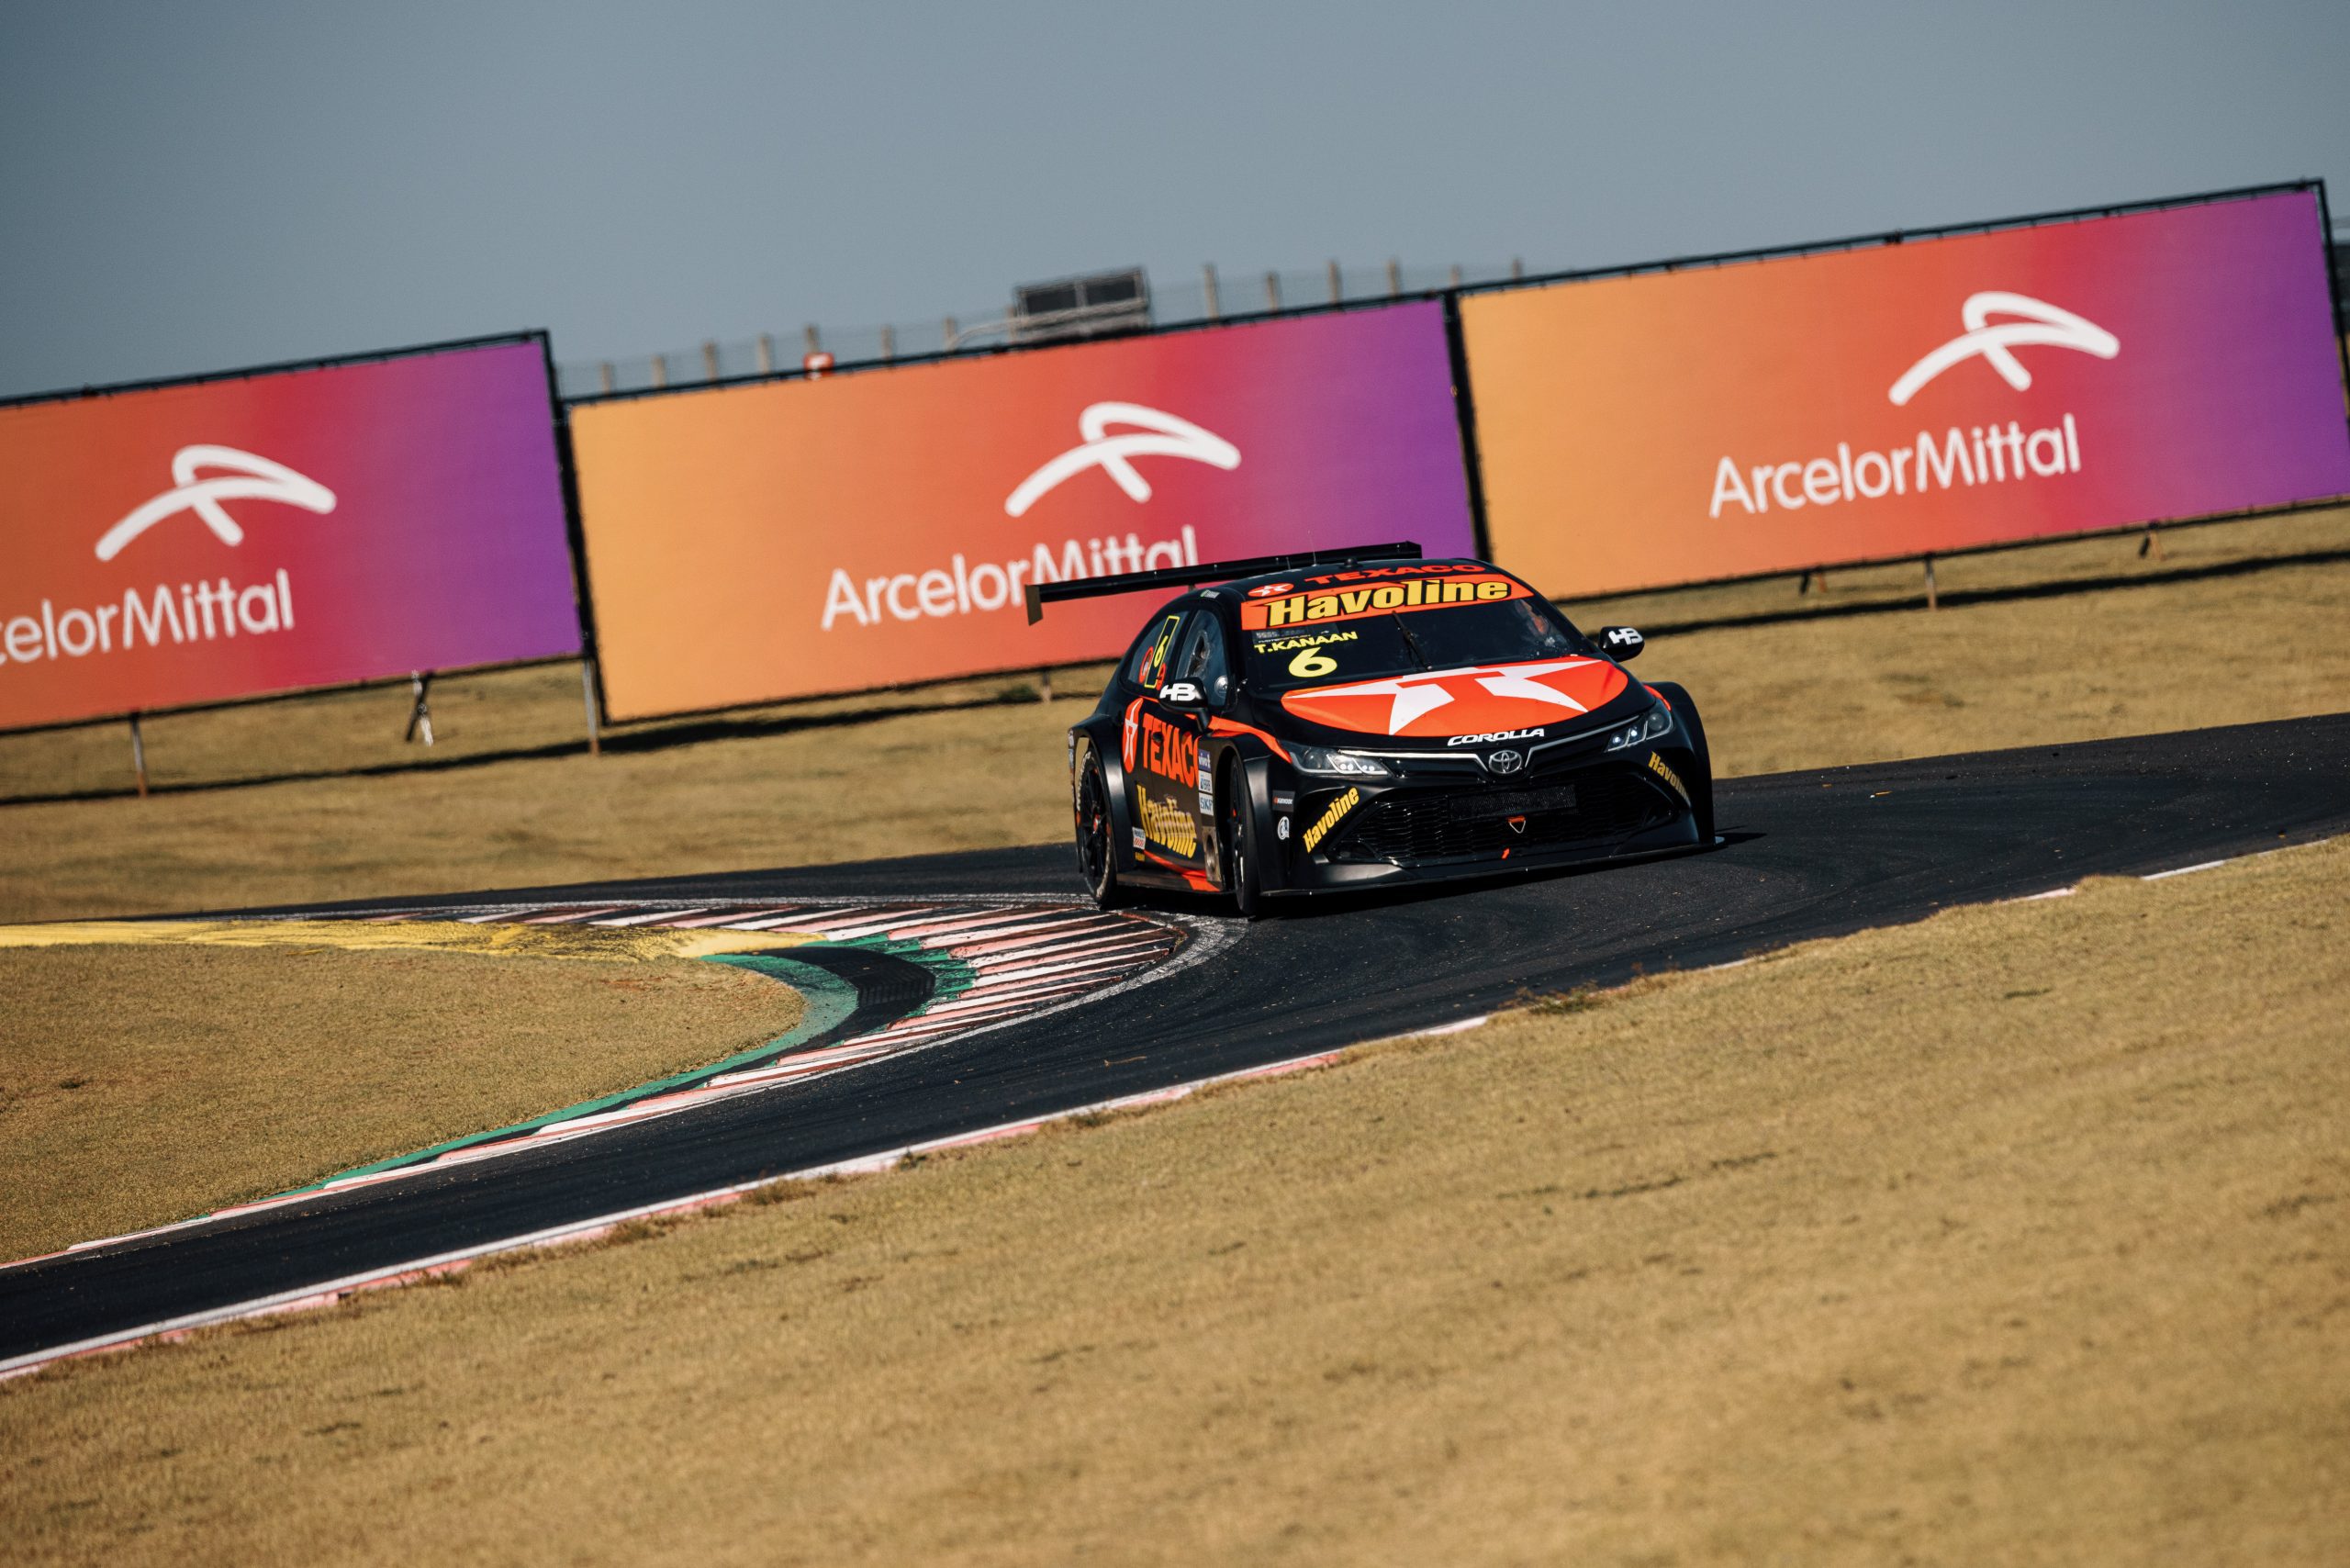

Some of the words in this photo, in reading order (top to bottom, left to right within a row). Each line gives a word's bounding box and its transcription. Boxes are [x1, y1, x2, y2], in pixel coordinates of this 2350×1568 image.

[1709, 412, 2081, 519] ArcelorMittal
[821, 524, 1199, 631] ArcelorMittal
[1264, 577, 1509, 627] Havoline
[1304, 564, 1486, 585] TEXACO
[0, 567, 295, 666] elorMittal
[1254, 631, 1359, 654] T.KANAAN
[1154, 635, 1169, 667] 6
[1288, 646, 1338, 678] 6
[1142, 712, 1199, 789] TEXAC
[1447, 728, 1545, 746] COROLLA
[1136, 784, 1197, 858] Havoline
[1303, 787, 1360, 854] Havoline
